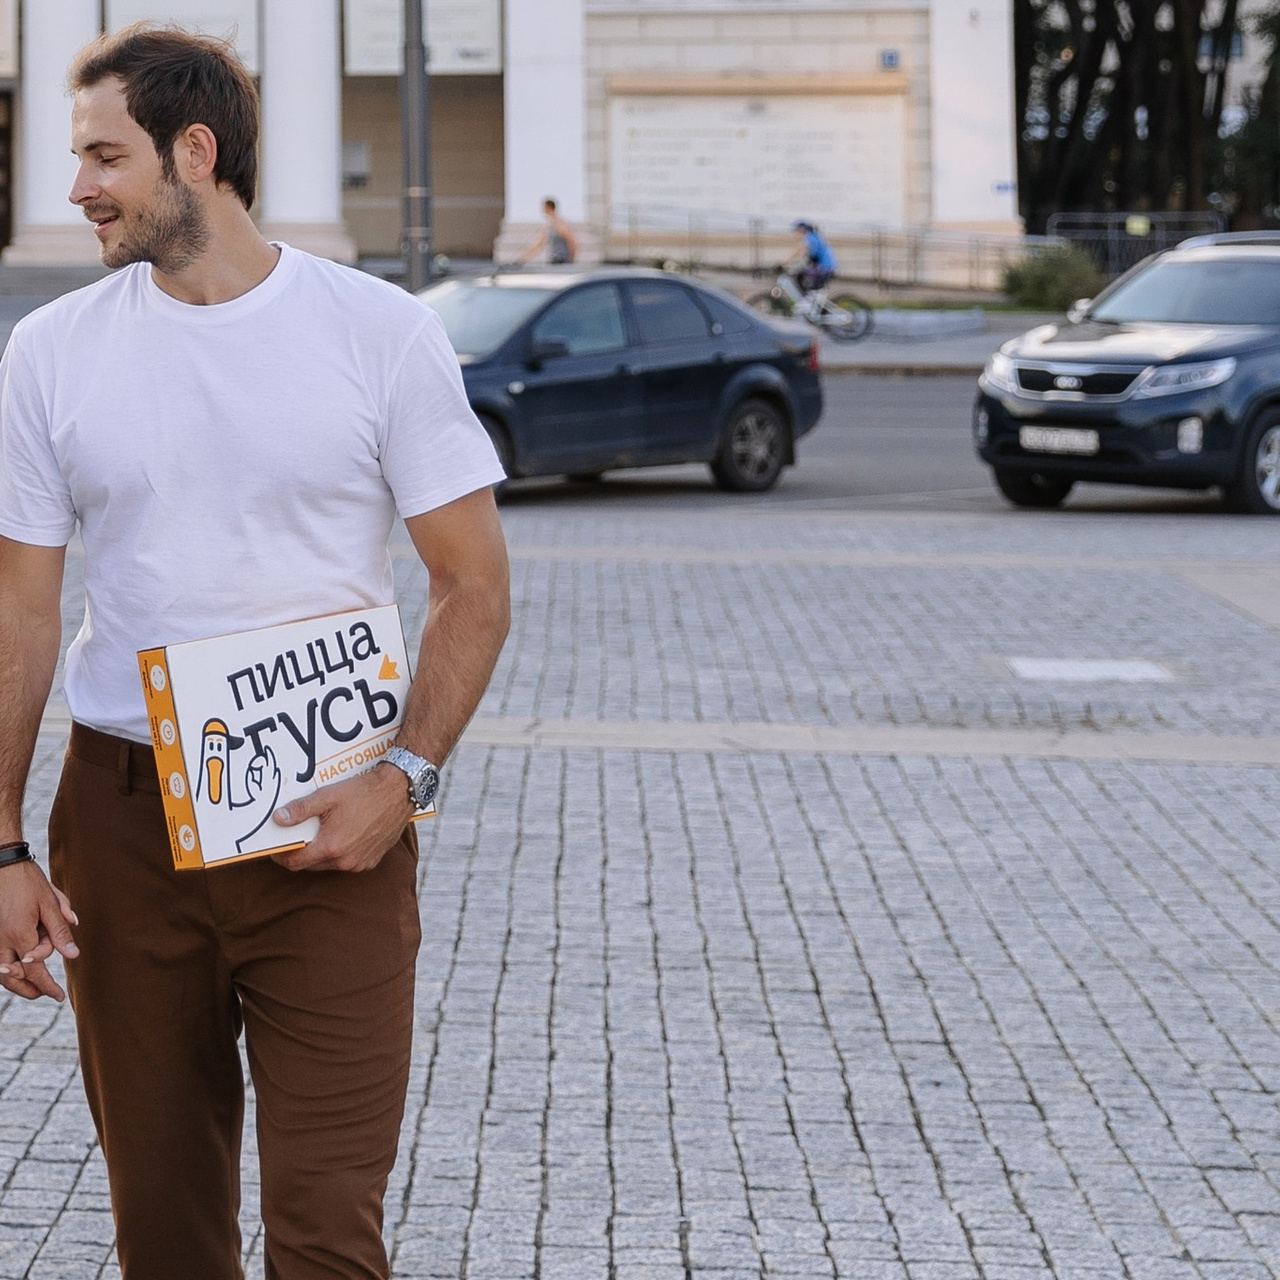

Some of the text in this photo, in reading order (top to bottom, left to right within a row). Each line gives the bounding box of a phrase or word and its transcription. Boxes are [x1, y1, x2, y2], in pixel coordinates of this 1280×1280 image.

[227, 621, 381, 711] пицца
[243, 678, 398, 783] гусь
[319, 738, 394, 783] НАСТОЯЩА
